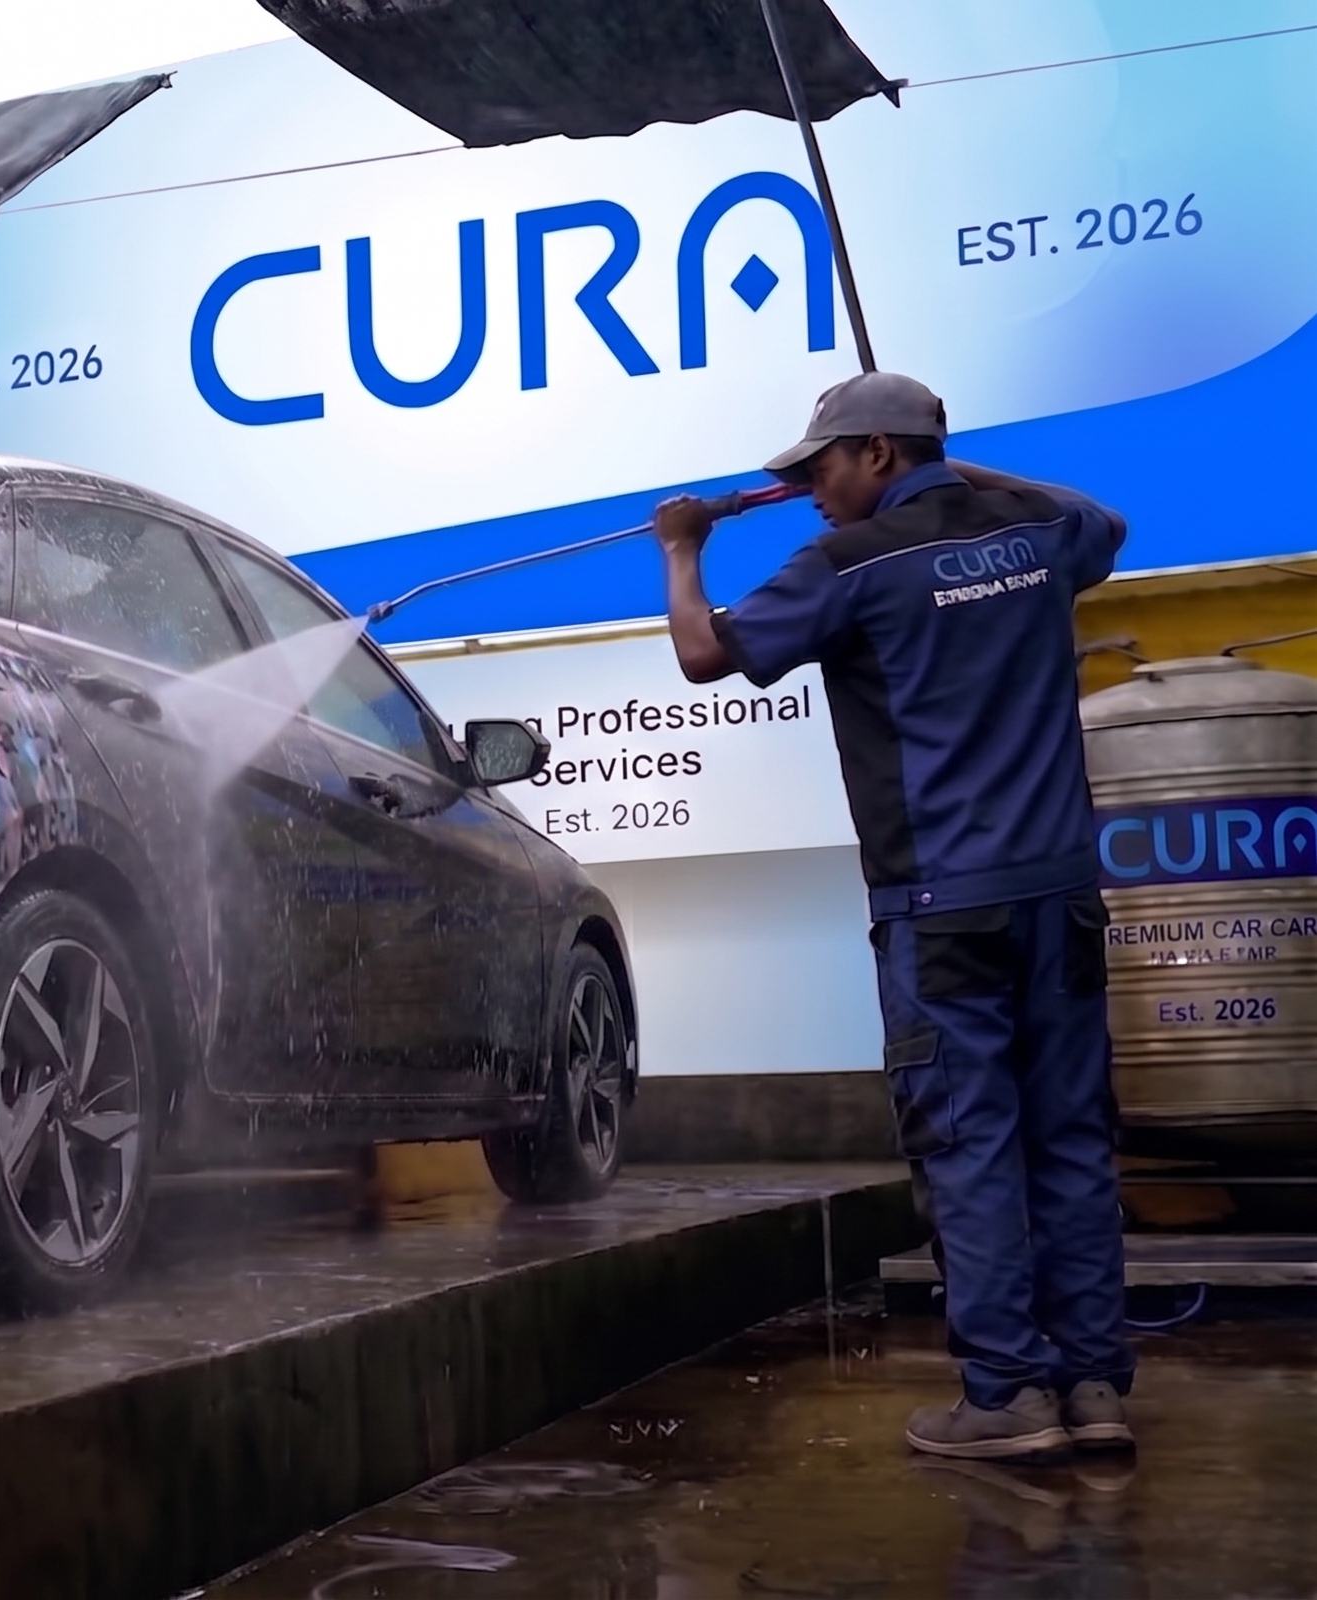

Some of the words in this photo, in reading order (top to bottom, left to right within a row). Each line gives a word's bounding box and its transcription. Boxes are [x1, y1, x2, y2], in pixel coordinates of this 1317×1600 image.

[957, 215, 1059, 267] EST.
[1075, 193, 1203, 251] 2026
[190, 171, 836, 426] CURA
[11, 344, 104, 390] 2026
[557, 685, 811, 739] Professional
[530, 748, 703, 787] Services
[545, 807, 600, 835] Est.
[612, 800, 691, 831] 2026
[1099, 806, 1317, 879] CURA
[1107, 921, 1204, 946] REMIUM
[1213, 918, 1263, 940] CAR
[1158, 1001, 1205, 1023] Est.
[1214, 997, 1277, 1022] 2026
